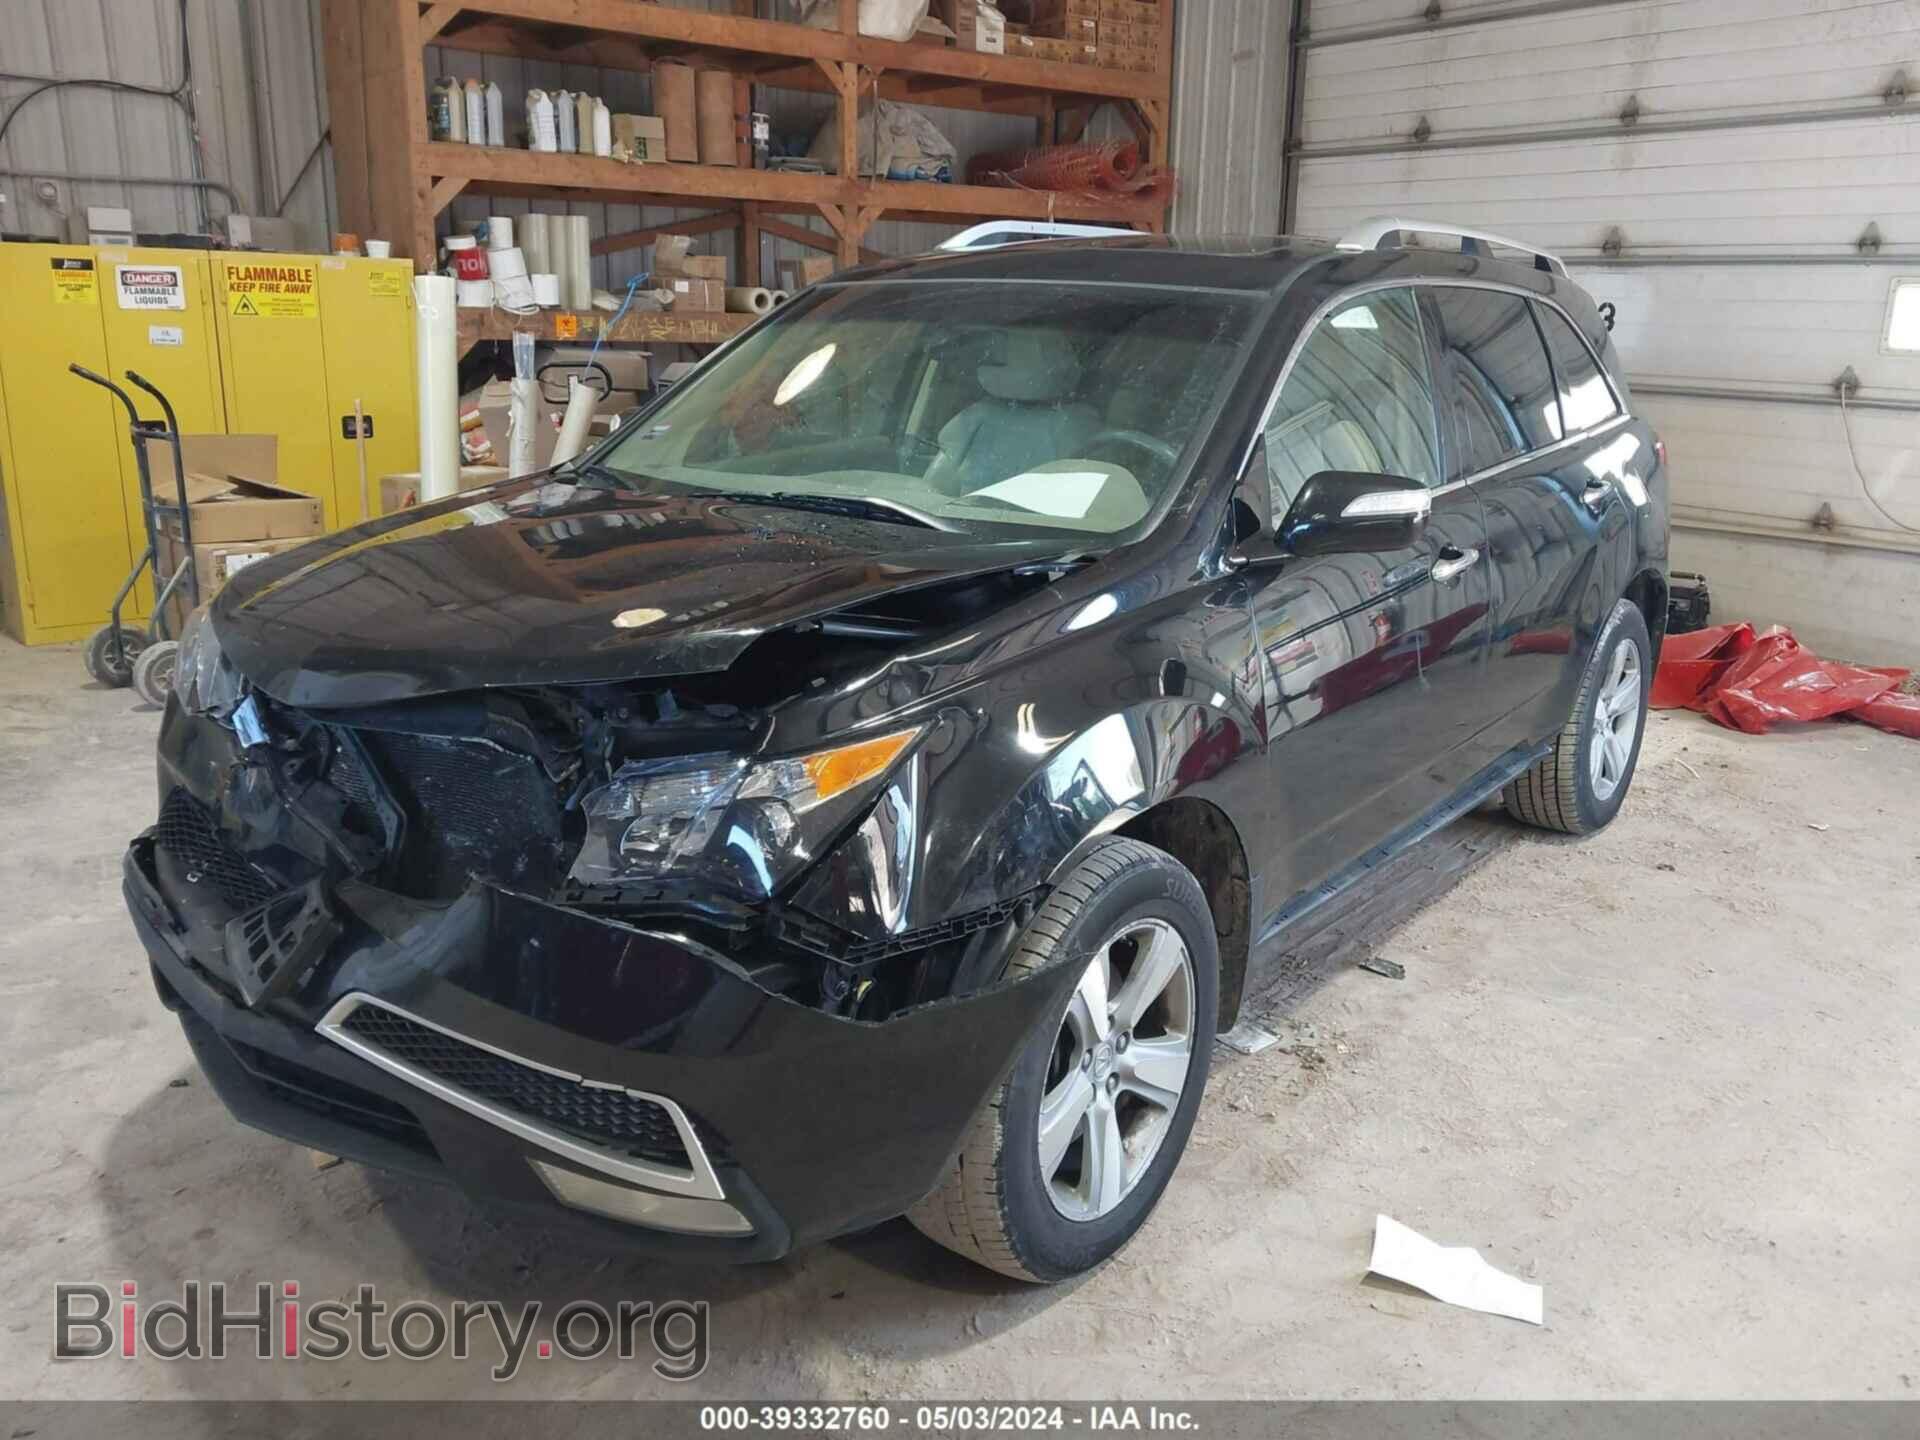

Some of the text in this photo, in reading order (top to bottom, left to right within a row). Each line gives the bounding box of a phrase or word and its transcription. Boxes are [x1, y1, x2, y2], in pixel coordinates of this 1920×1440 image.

[124, 271, 174, 286] DANGER
[227, 266, 313, 282] FLAMMABLE
[124, 286, 176, 296] FLAMMABLE
[229, 281, 312, 294] KEEP FIRE AWAY
[134, 295, 169, 305] LIQUIDS
